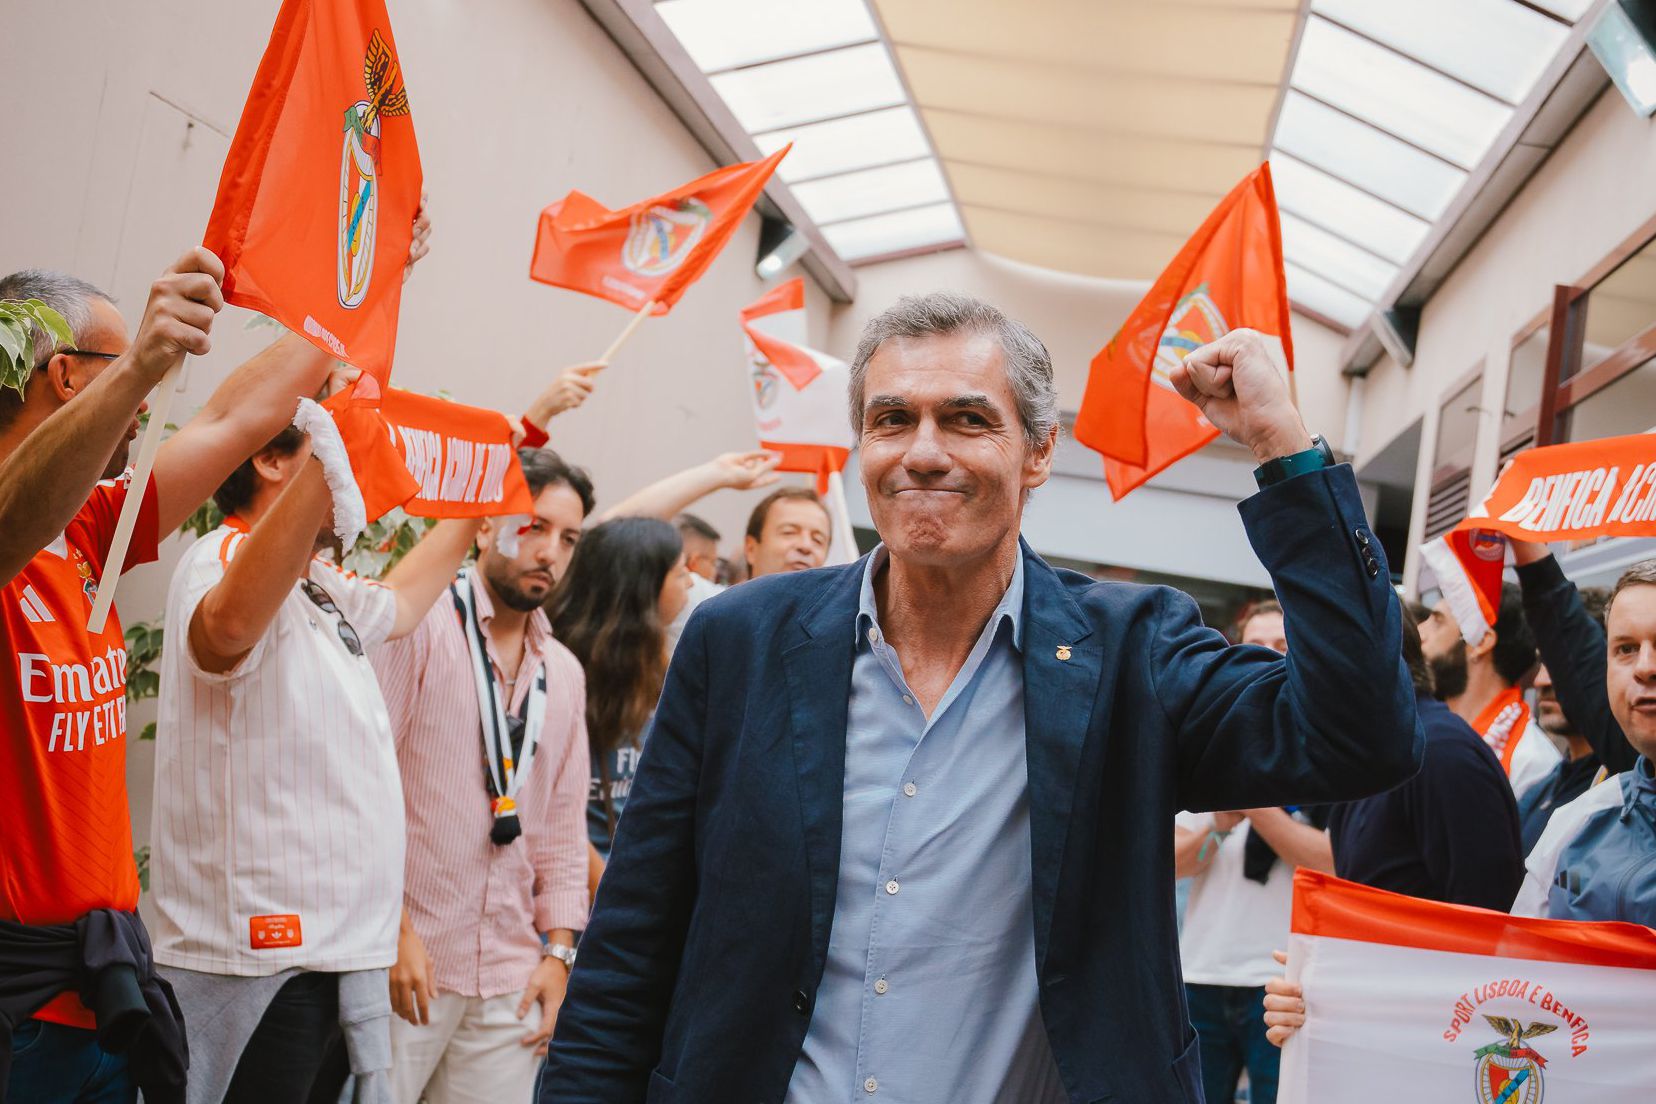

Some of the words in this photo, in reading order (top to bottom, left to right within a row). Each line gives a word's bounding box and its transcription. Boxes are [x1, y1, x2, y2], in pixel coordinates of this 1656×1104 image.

[1498, 466, 1619, 532] BENFICA
[1606, 461, 1656, 523] ACI
[48, 710, 91, 752] FLY
[1443, 993, 1476, 1042] SPORT
[1474, 979, 1530, 1005] LISBOA
[1528, 984, 1542, 1004] E
[1540, 993, 1590, 1058] BENFICA
